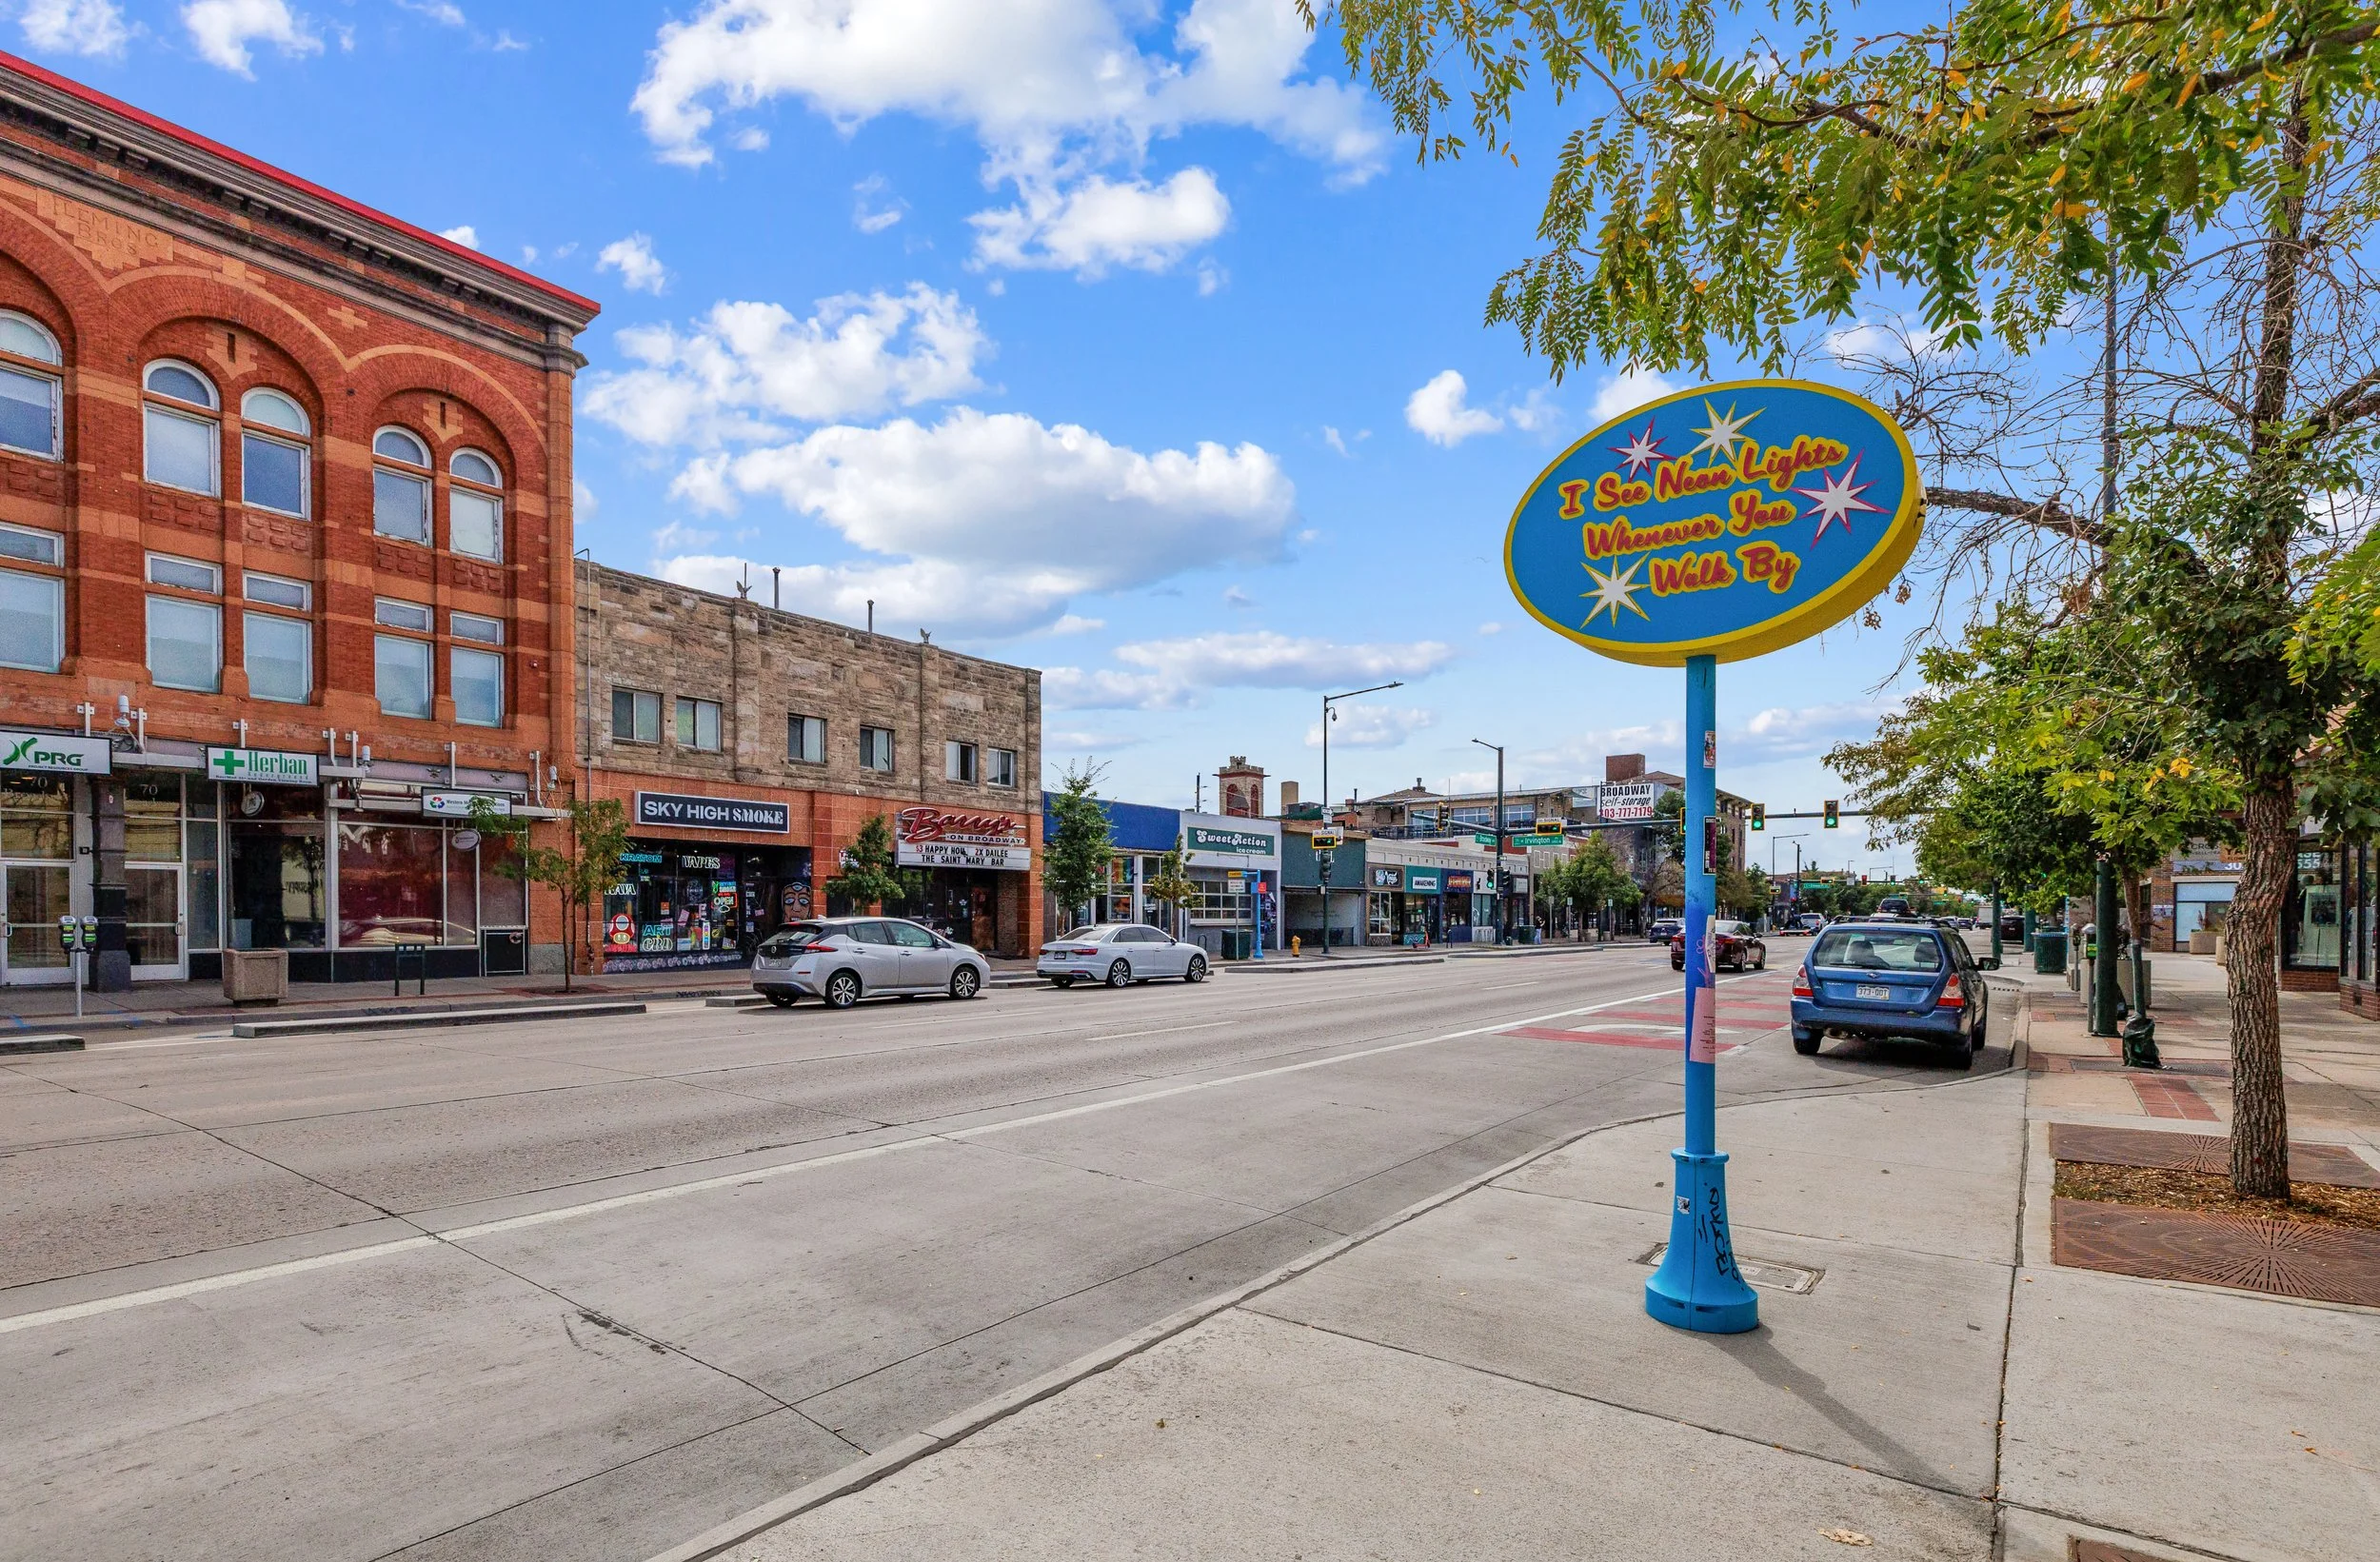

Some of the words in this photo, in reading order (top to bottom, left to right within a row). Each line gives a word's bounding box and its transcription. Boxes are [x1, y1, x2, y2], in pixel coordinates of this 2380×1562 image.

[52, 194, 159, 247] FLEMING
[77, 221, 138, 257] BROS
[1561, 482, 1586, 517] I
[1596, 475, 1649, 509] See
[1656, 458, 1734, 500] Neon
[1740, 438, 1846, 489] Lights
[1585, 517, 1722, 557] Whenever
[1731, 492, 1794, 534] You
[1652, 553, 1734, 595] Walk
[1738, 544, 1798, 591] By
[34, 750, 85, 766] PRG
[248, 751, 307, 775] Herban
[1601, 784, 1651, 798] BROADWAY
[1601, 797, 1652, 807] self-storage
[644, 801, 684, 819] SKY
[686, 803, 729, 821] HIGH
[732, 807, 783, 825] SMOKE
[901, 806, 1017, 844] Barry's
[967, 835, 1022, 844] BROADWAY
[1196, 829, 1232, 844] Sweet
[1231, 833, 1266, 847] Action
[916, 844, 923, 853] $3
[924, 844, 948, 855] HAPPY
[620, 853, 663, 863] KRATOM
[682, 856, 721, 870] VAPES
[922, 855, 935, 863] THE
[941, 855, 961, 864] SAINT
[965, 856, 984, 865] MARY
[991, 858, 1004, 866] BAR
[1414, 879, 1437, 888] AWAKENING
[713, 896, 734, 906] OPEN
[642, 924, 673, 937] ART
[642, 938, 673, 952] CBD
